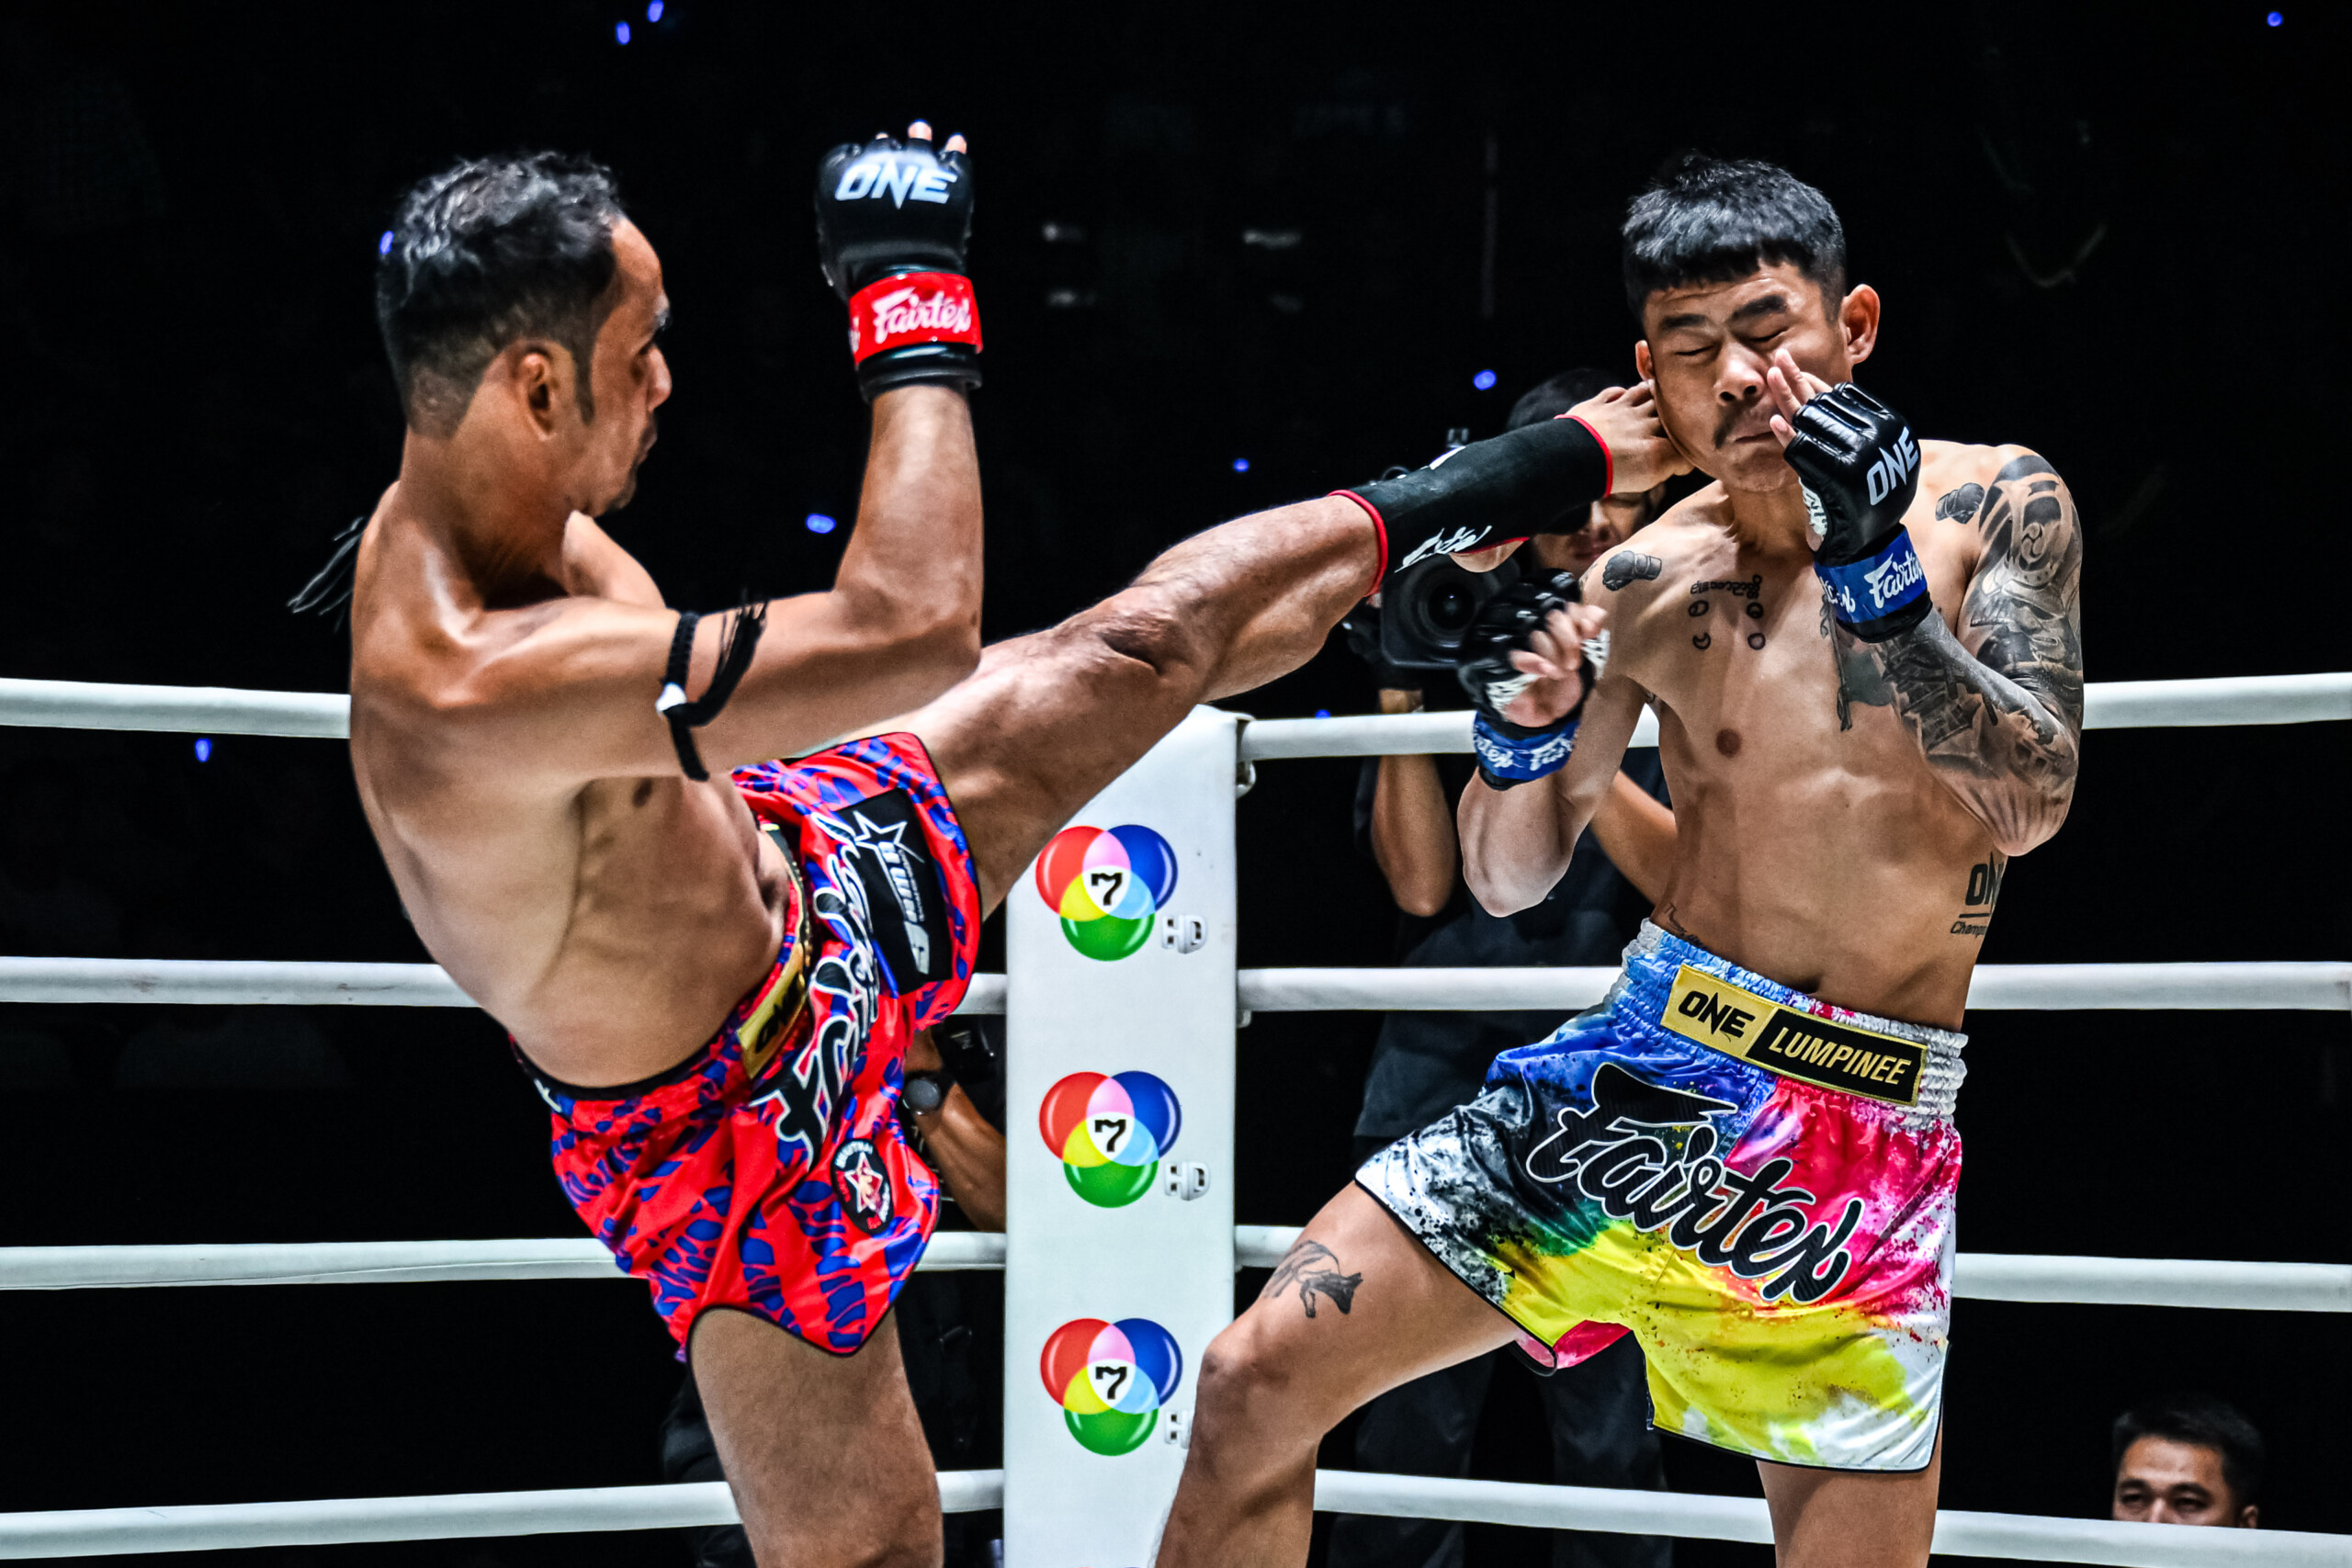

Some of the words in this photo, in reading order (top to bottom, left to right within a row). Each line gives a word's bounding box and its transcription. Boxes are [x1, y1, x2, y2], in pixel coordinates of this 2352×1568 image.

[835, 158, 958, 209] ONE
[871, 287, 972, 344] Fairtex
[1866, 426, 1919, 506] ONE
[1091, 872, 1123, 907] 7
[1160, 914, 1208, 954] HD
[1964, 851, 2005, 915] ON
[1678, 990, 1757, 1040] ONE
[1768, 1026, 1912, 1086] LUMPINEE
[1093, 1118, 1127, 1153] 7
[1163, 1161, 1211, 1201] HD
[1525, 1062, 1864, 1304] Fairtex
[1094, 1365, 1128, 1400] 7
